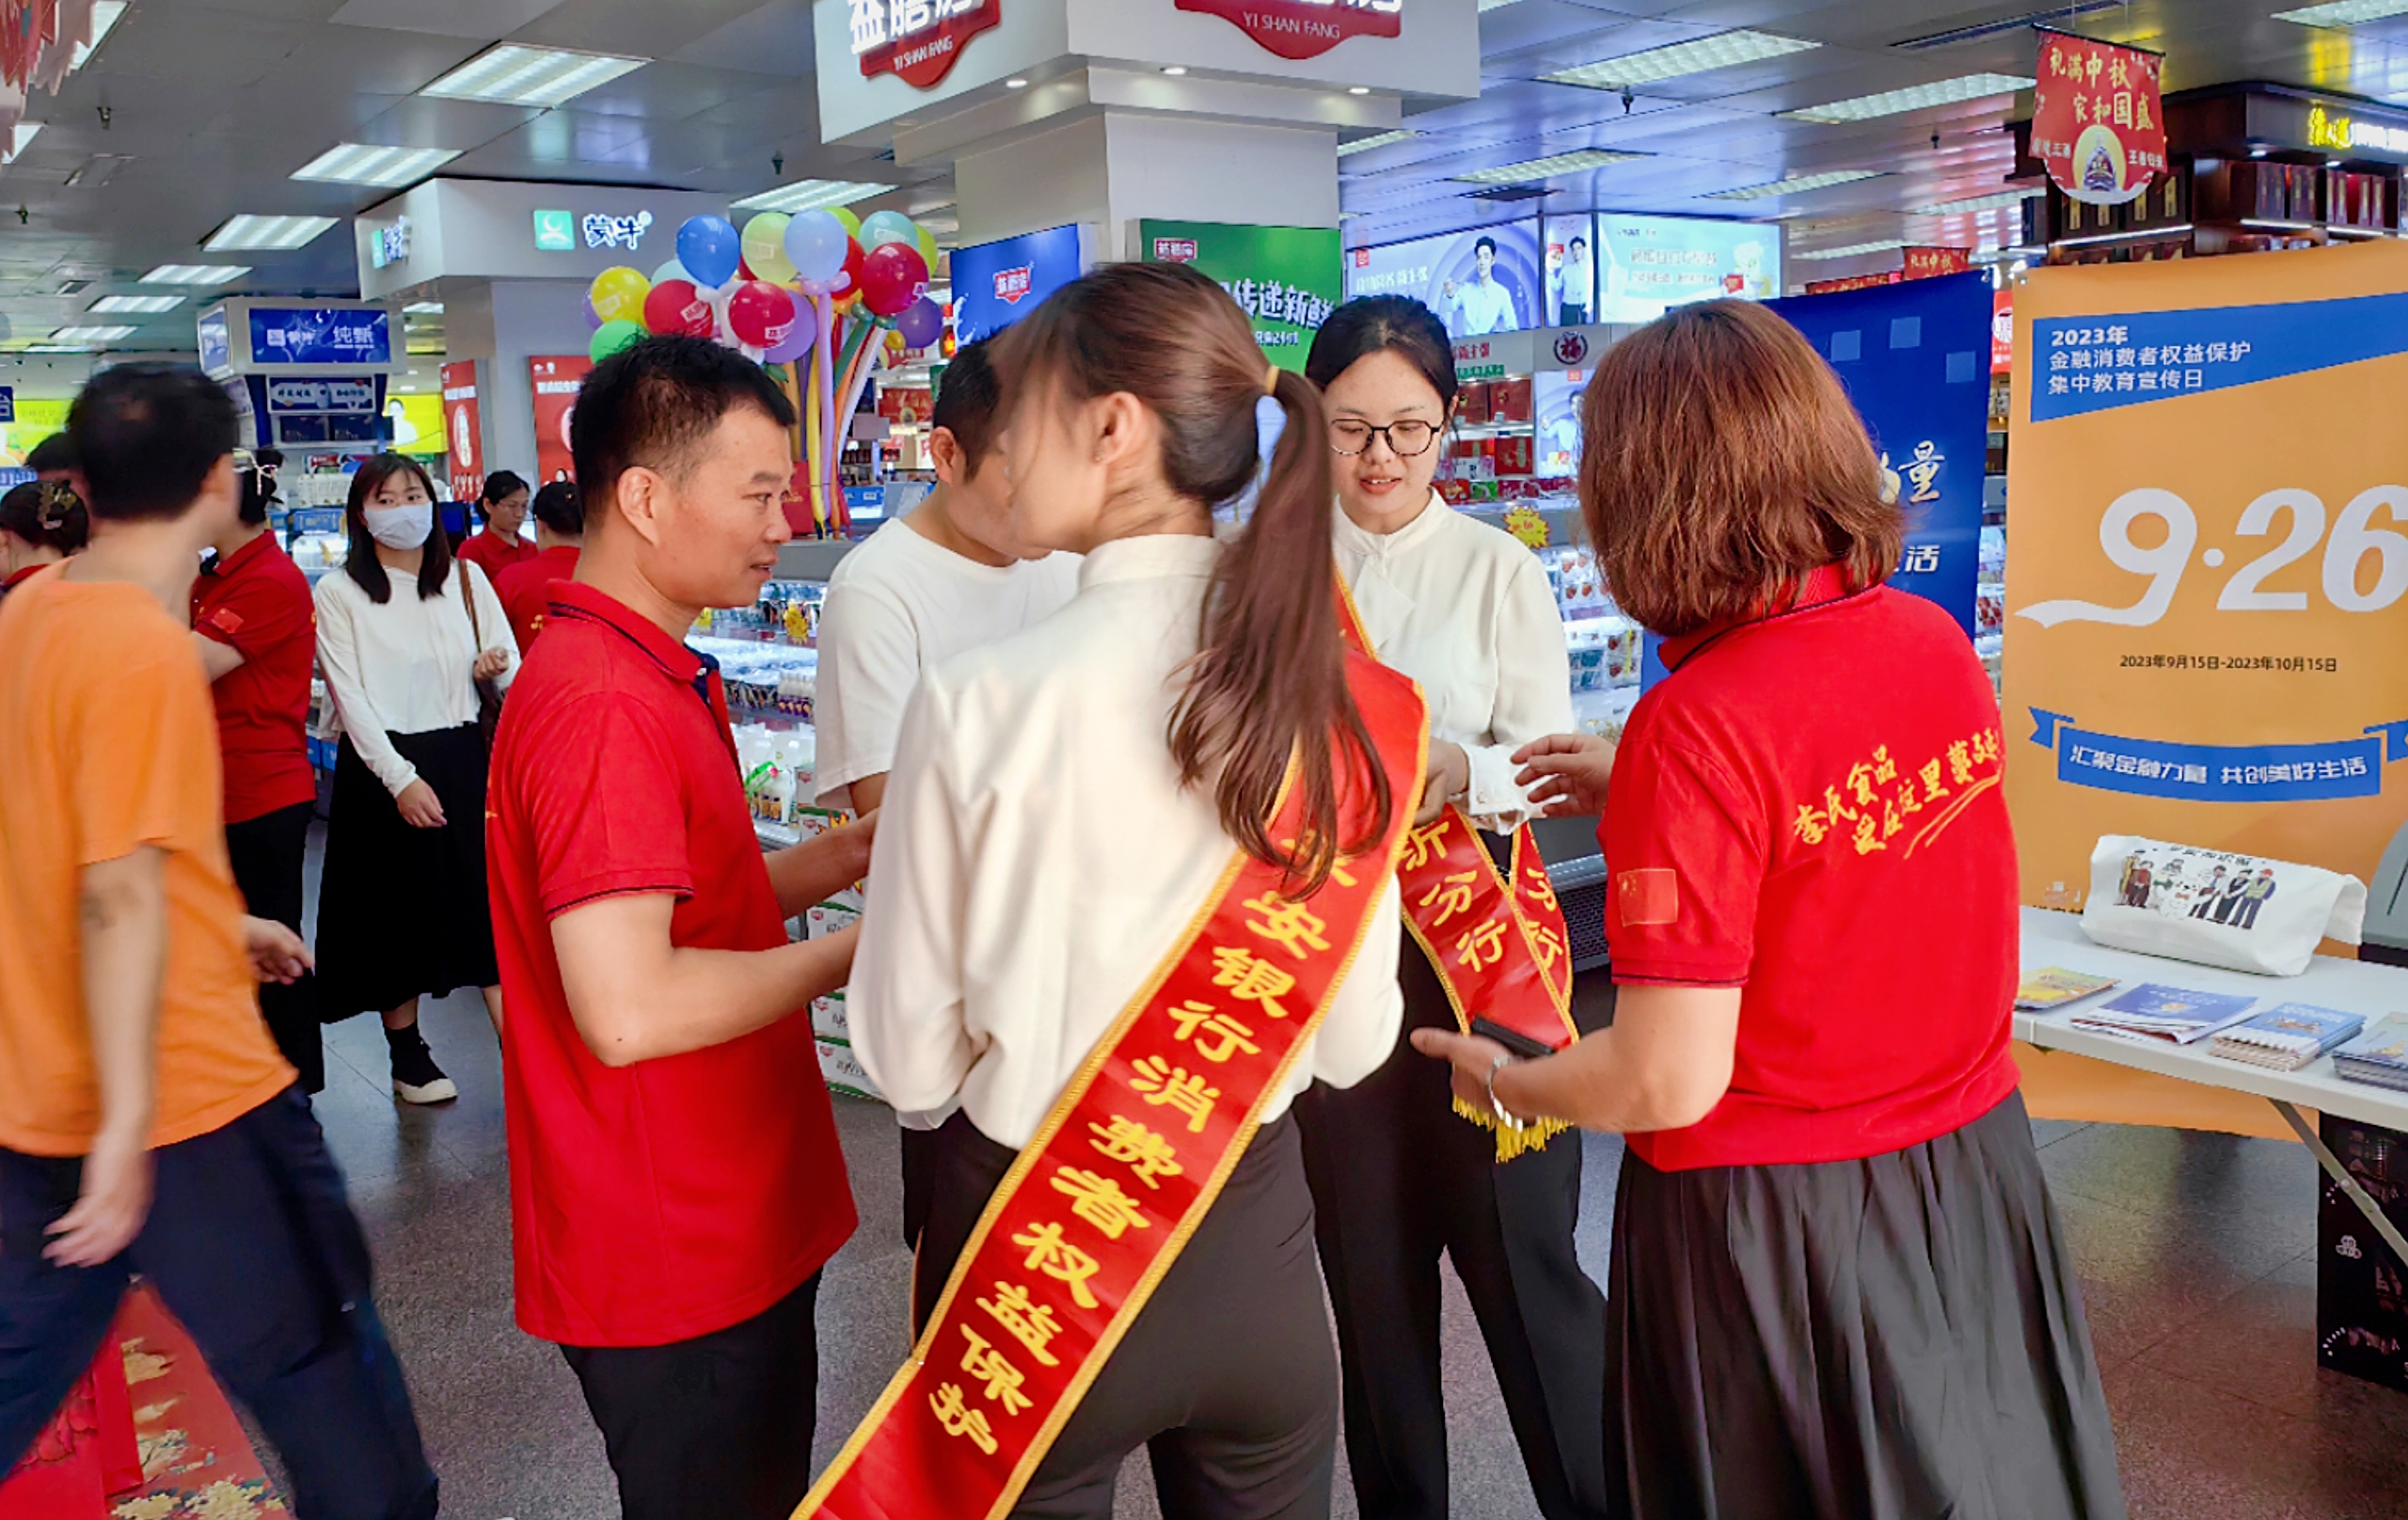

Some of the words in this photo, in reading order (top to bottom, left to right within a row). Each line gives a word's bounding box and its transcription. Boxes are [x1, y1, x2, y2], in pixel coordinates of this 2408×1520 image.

[1243, 11, 1259, 27] YI
[1261, 14, 1300, 33] SHAN
[1304, 22, 1341, 40] FANG
[2050, 46, 2132, 90] 礼满中秋
[2073, 91, 2154, 131] 家和国盛
[582, 214, 642, 250] 蒙牛
[1220, 278, 1336, 329] 传递新鲜
[2051, 325, 2129, 346] 2023年
[2049, 340, 2251, 372] 金融消费者权益保护
[2048, 369, 2203, 395] 集中教育宣传日
[2119, 655, 2337, 673] 2023年9月15日-2023年10月15日
[2070, 744, 2208, 784] 汇聚金融力量
[2220, 755, 2368, 784] 共创美好生活
